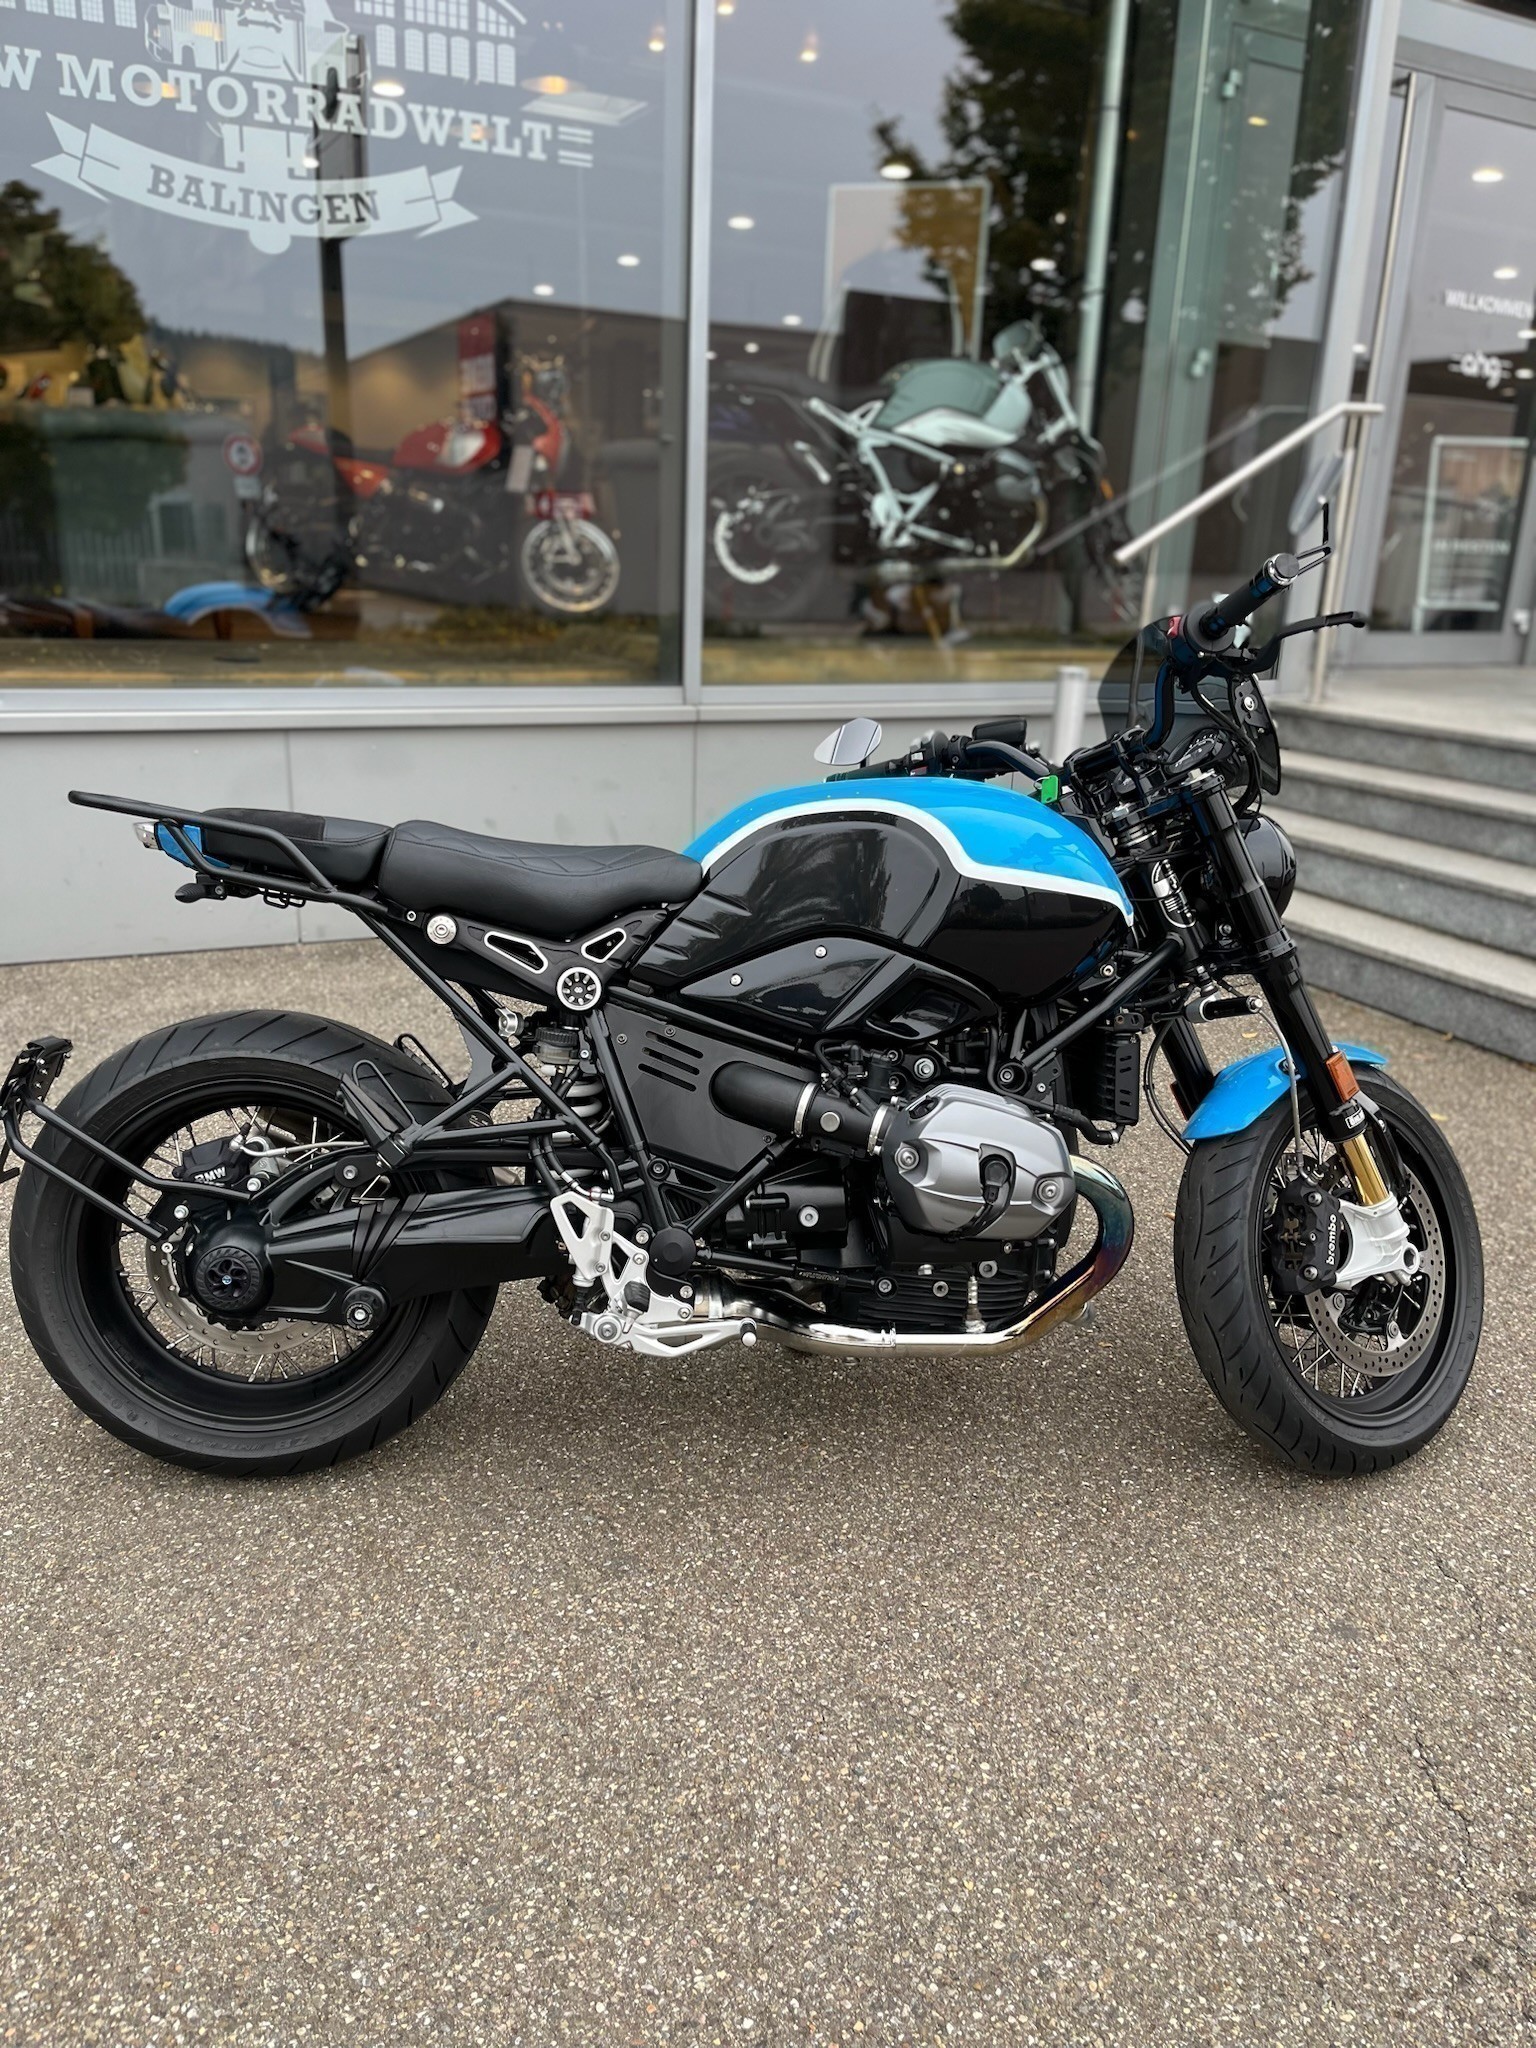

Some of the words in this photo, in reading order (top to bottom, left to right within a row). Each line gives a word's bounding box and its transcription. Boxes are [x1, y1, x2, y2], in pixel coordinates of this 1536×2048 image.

[56, 52, 552, 162] MOTORRADWELT
[146, 163, 381, 225] BALINGEN
[1326, 1213, 1337, 1265] brembo
